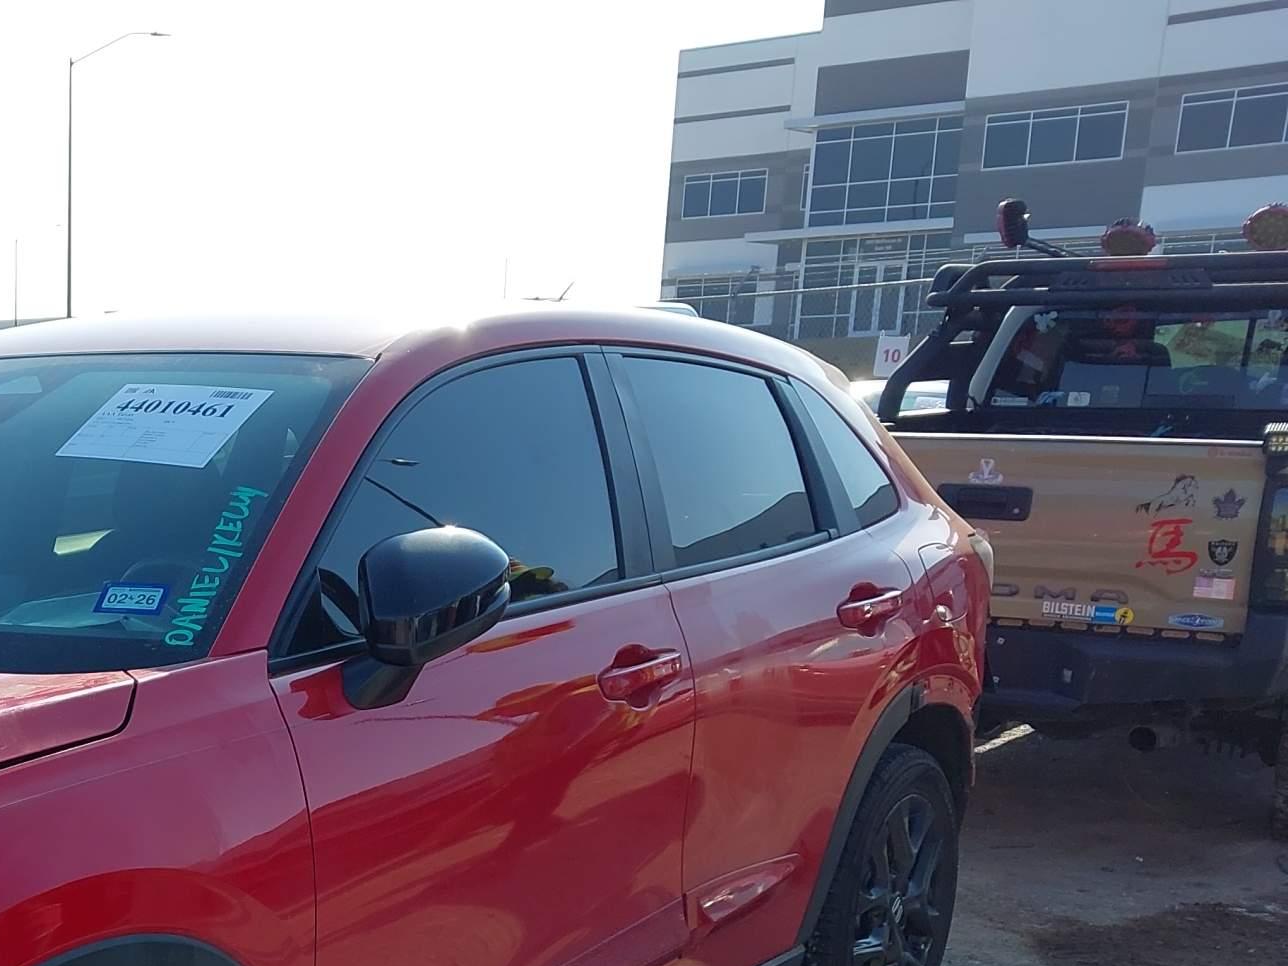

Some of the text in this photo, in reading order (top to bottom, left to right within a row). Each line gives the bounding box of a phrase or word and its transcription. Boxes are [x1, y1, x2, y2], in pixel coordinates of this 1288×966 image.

[883, 348, 901, 363] 10
[116, 398, 235, 418] 44010461
[1135, 518, 1198, 574] 馬
[107, 592, 157, 606] 02 26
[1042, 601, 1096, 617] BILSTEIN
